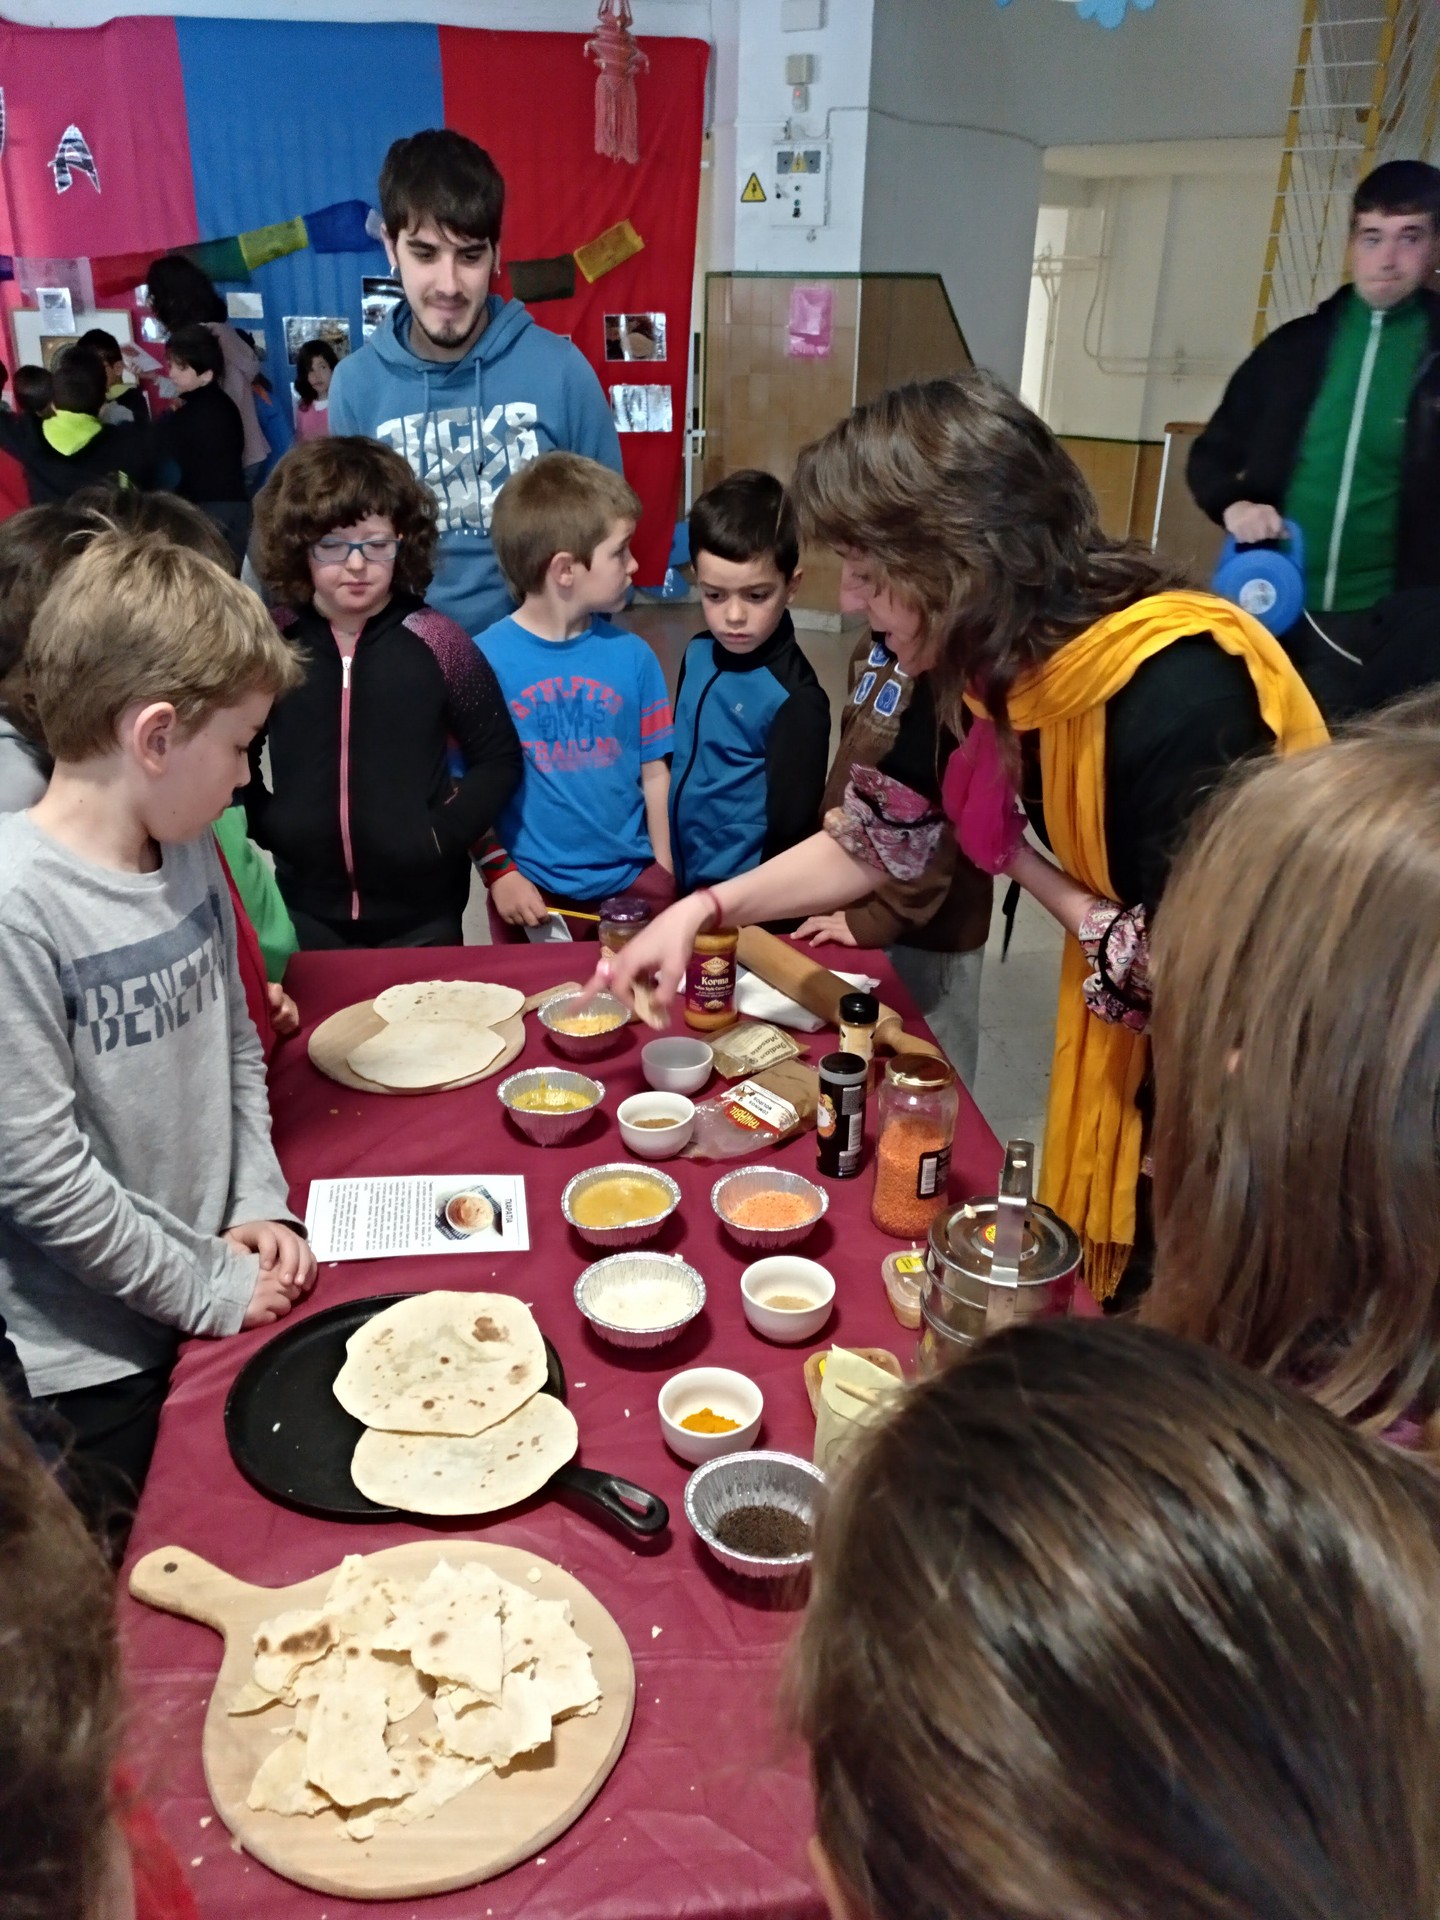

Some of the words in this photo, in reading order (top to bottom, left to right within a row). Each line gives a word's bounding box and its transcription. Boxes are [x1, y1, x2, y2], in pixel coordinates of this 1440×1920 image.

[701, 976, 729, 986] Korma
[750, 1034, 778, 1056] Masala
[748, 1100, 769, 1116] COMINOS
[753, 1096, 773, 1111] MOLIDOS
[729, 1105, 761, 1130] TAWABIL
